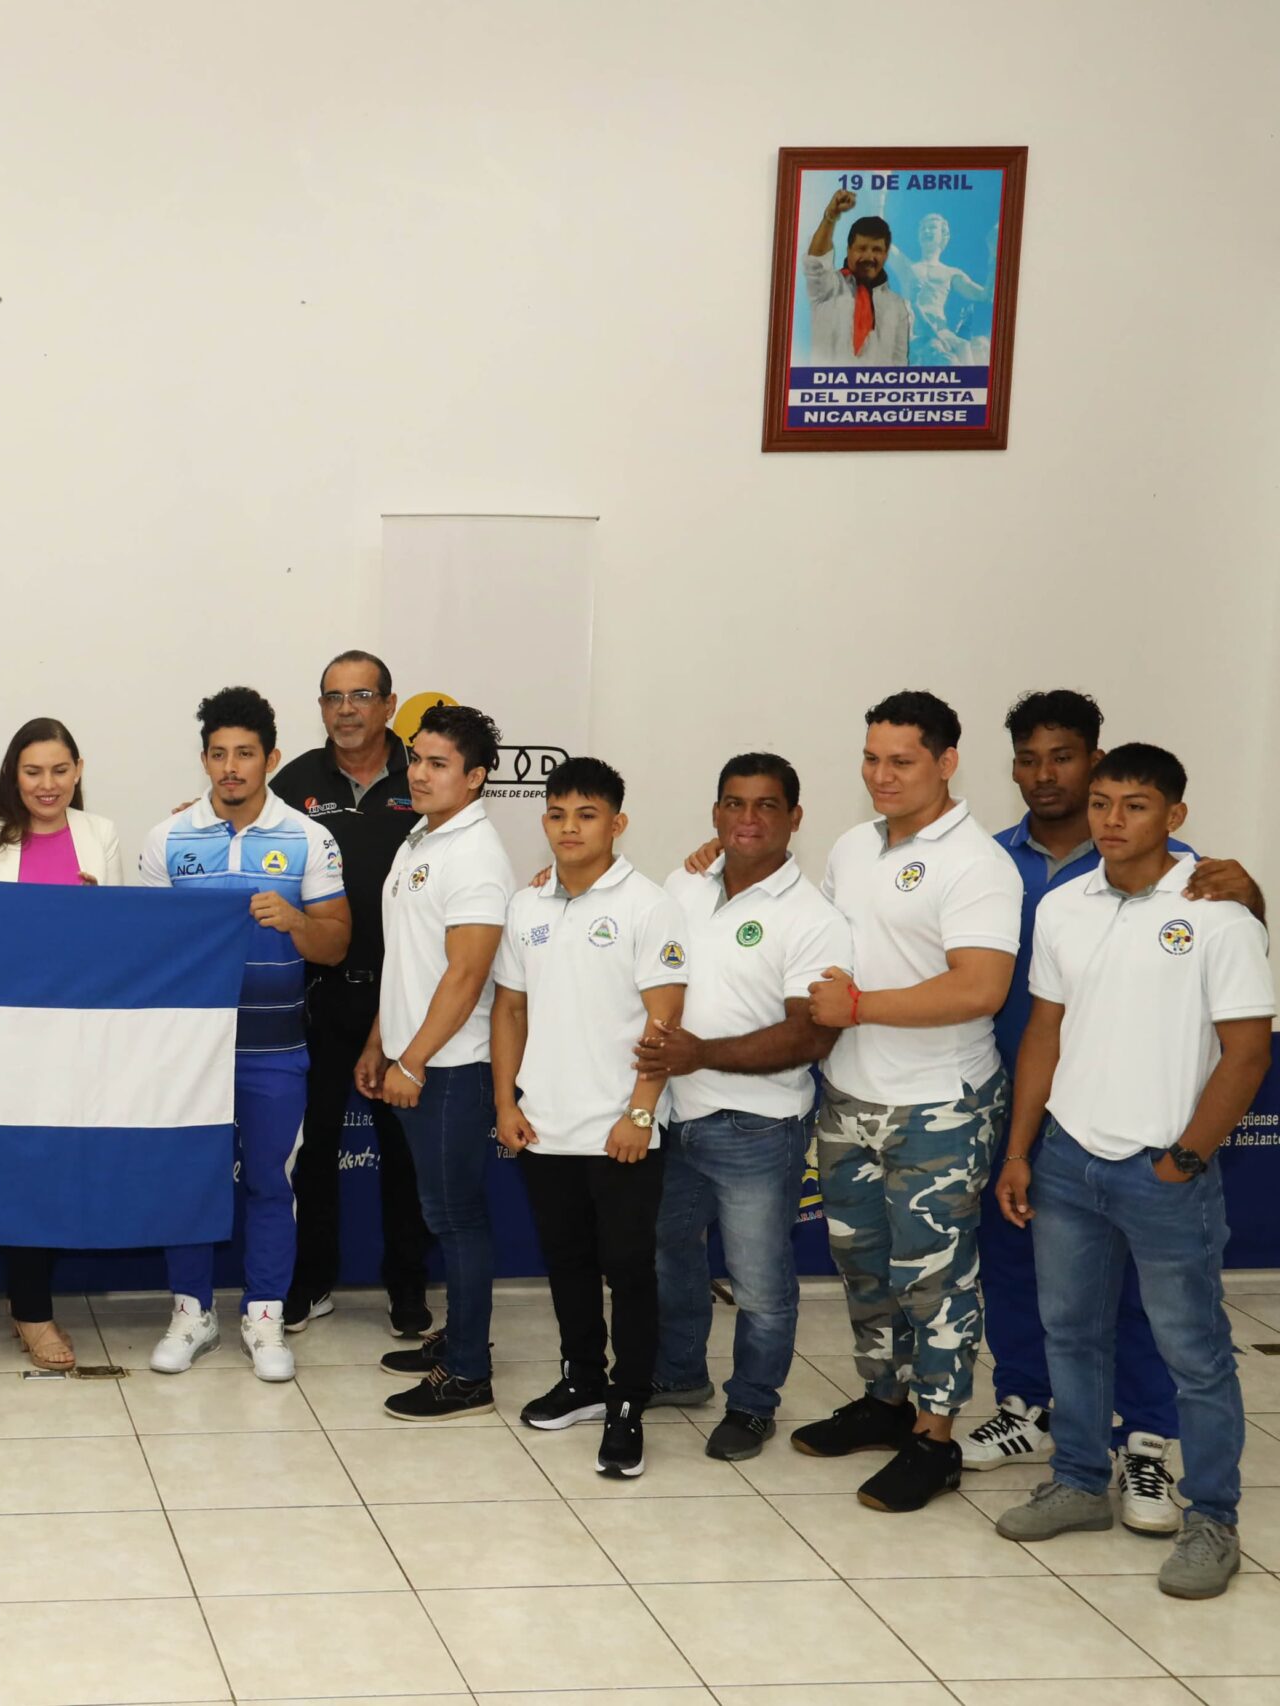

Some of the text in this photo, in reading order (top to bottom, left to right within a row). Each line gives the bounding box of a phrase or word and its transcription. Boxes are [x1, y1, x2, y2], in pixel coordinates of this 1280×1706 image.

[838, 174, 973, 190] 19 DE ABRIL
[813, 371, 961, 385] DIA NACIONAL
[800, 391, 975, 403] DEL DEPORTISTA
[804, 408, 968, 424] NICARAGÜENSE
[509, 790, 521, 798] DE
[522, 790, 547, 798] DEPO
[1237, 1112, 1279, 1130] güense
